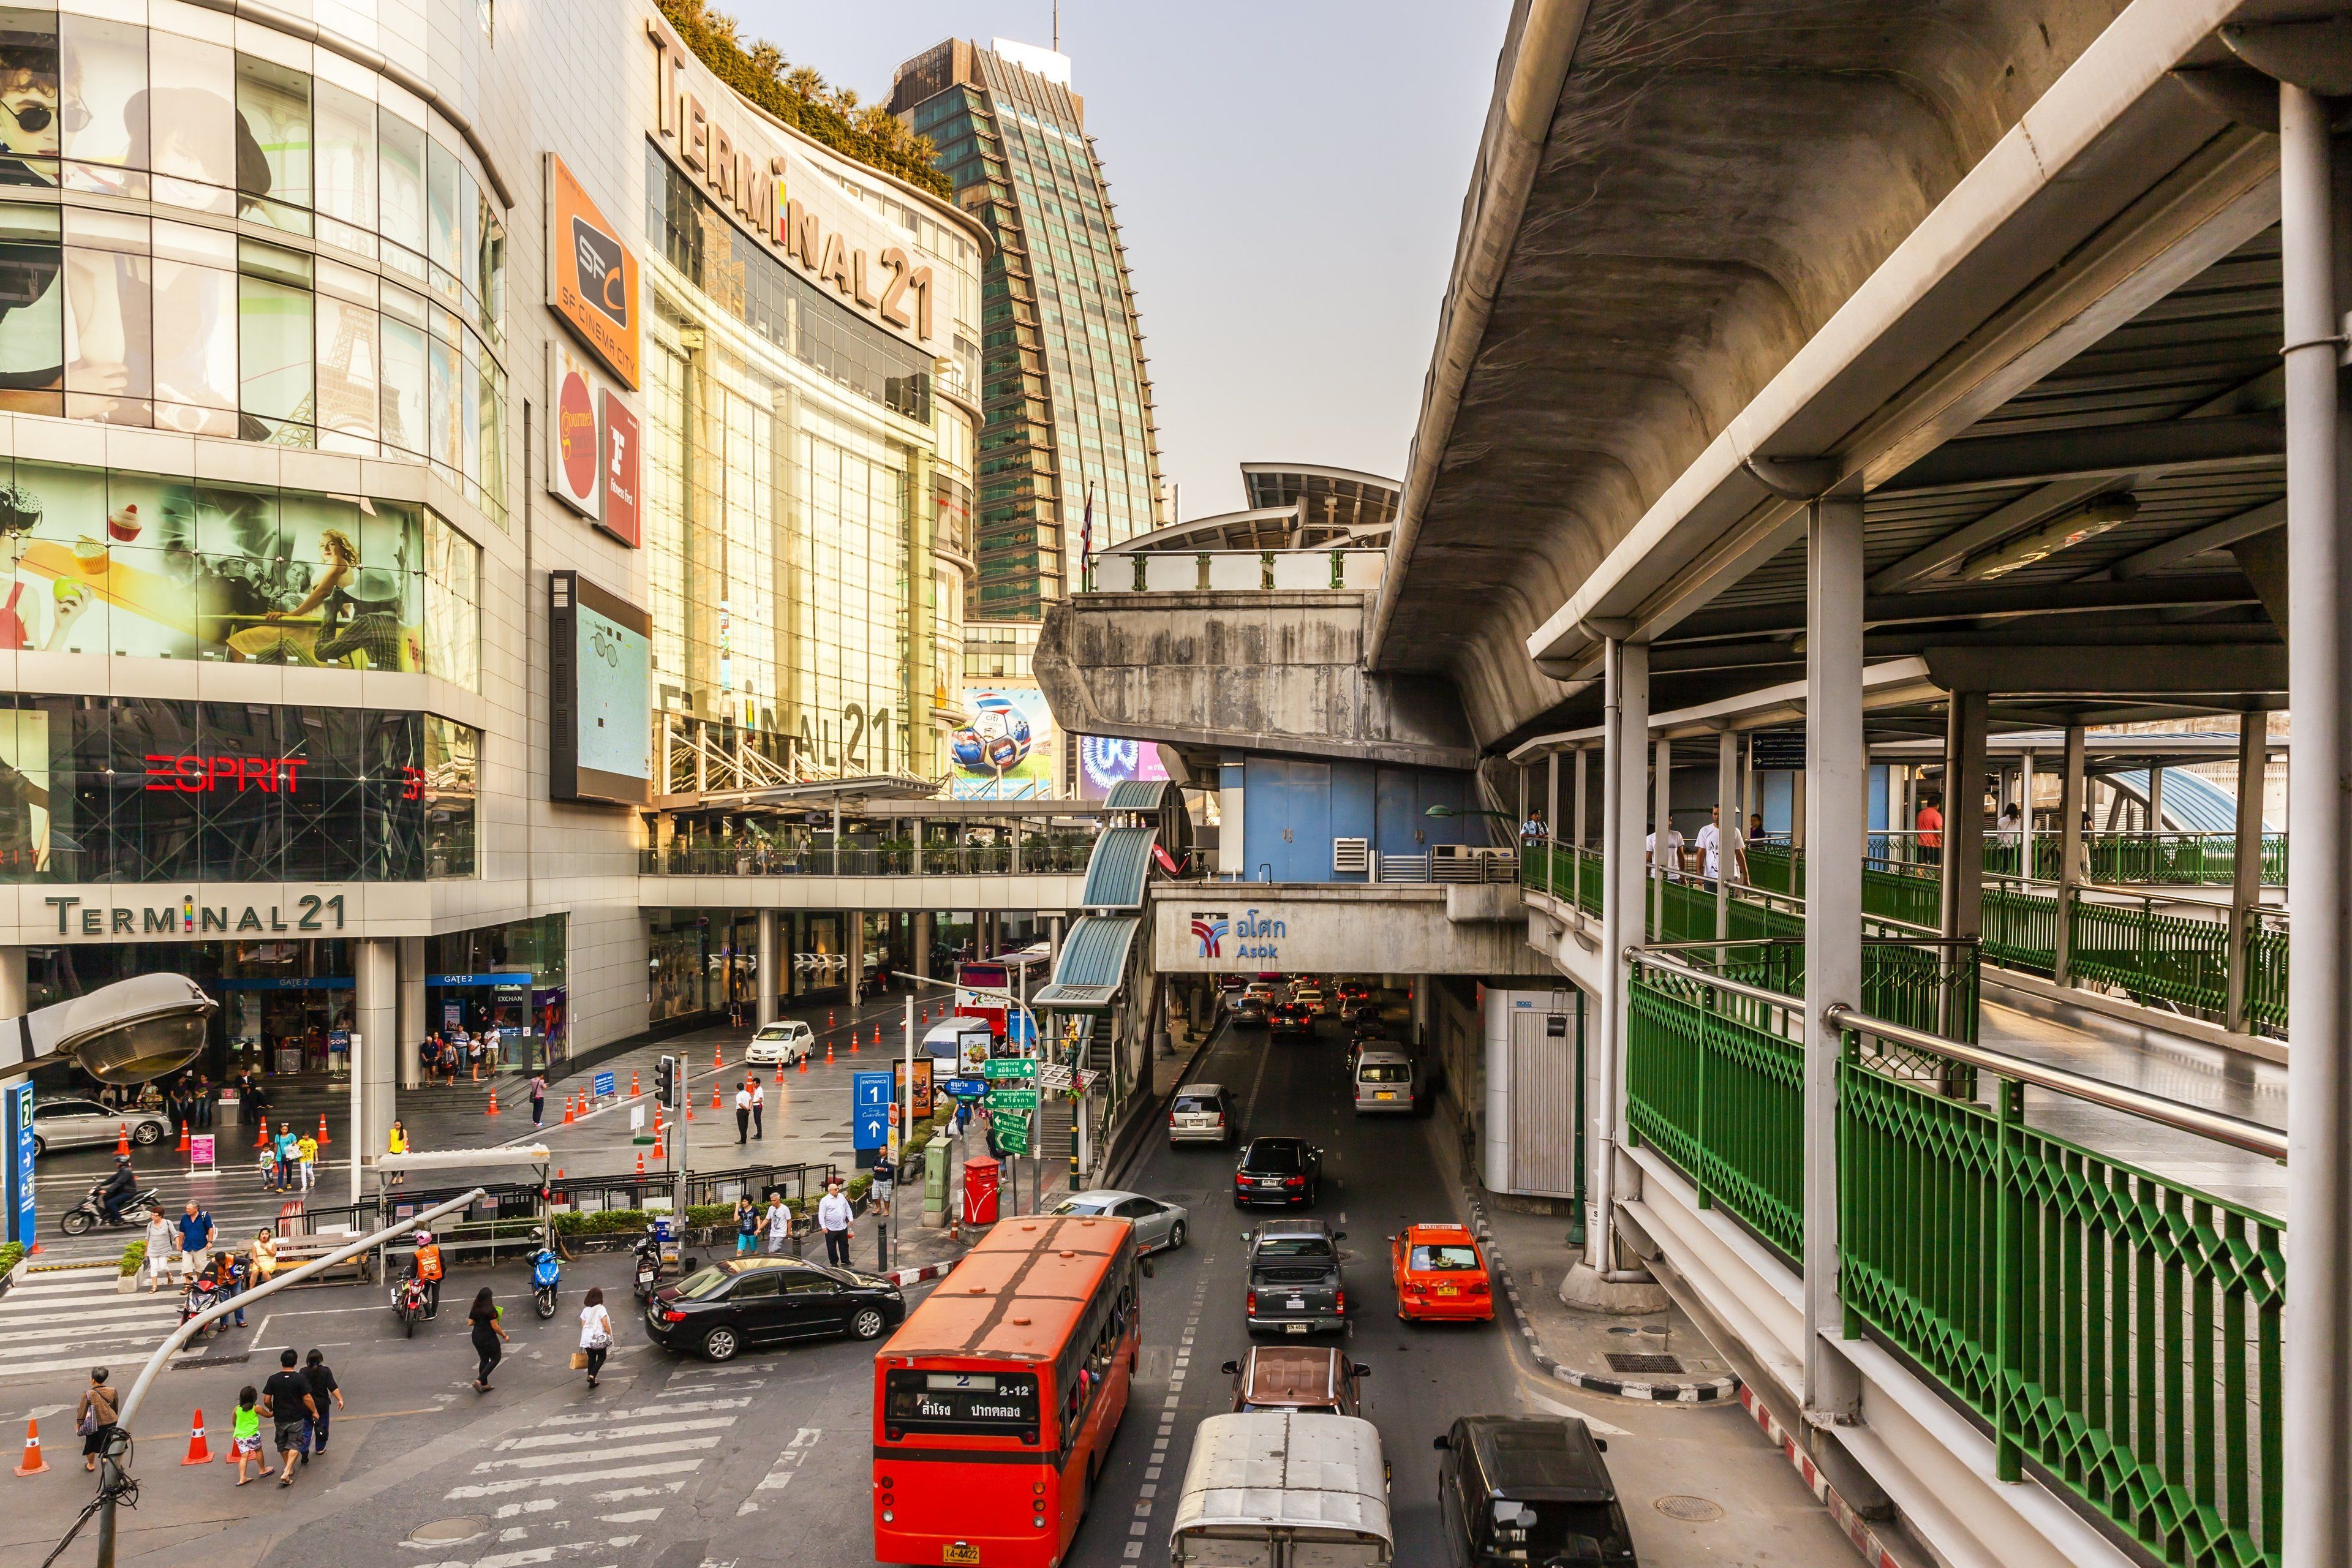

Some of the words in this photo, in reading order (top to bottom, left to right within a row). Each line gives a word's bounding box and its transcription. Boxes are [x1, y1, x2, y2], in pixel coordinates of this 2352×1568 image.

[562, 285, 576, 314] SF
[579, 303, 616, 357] CINEMA
[617, 346, 635, 377] CITY
[145, 755, 307, 793] ESPRIT
[1237, 908, 1286, 938] อโศก
[1237, 943, 1278, 958] Asok
[870, 1087, 878, 1102] 1
[977, 1084, 984, 1092] 19
[23, 1104, 30, 1126] 2
[956, 1376, 970, 1386] 2
[1000, 1386, 1029, 1395] 2-12
[922, 1401, 951, 1415] สำโรง
[971, 1404, 1020, 1417] ปากคลอง
[946, 1549, 978, 1559] 14-4422
